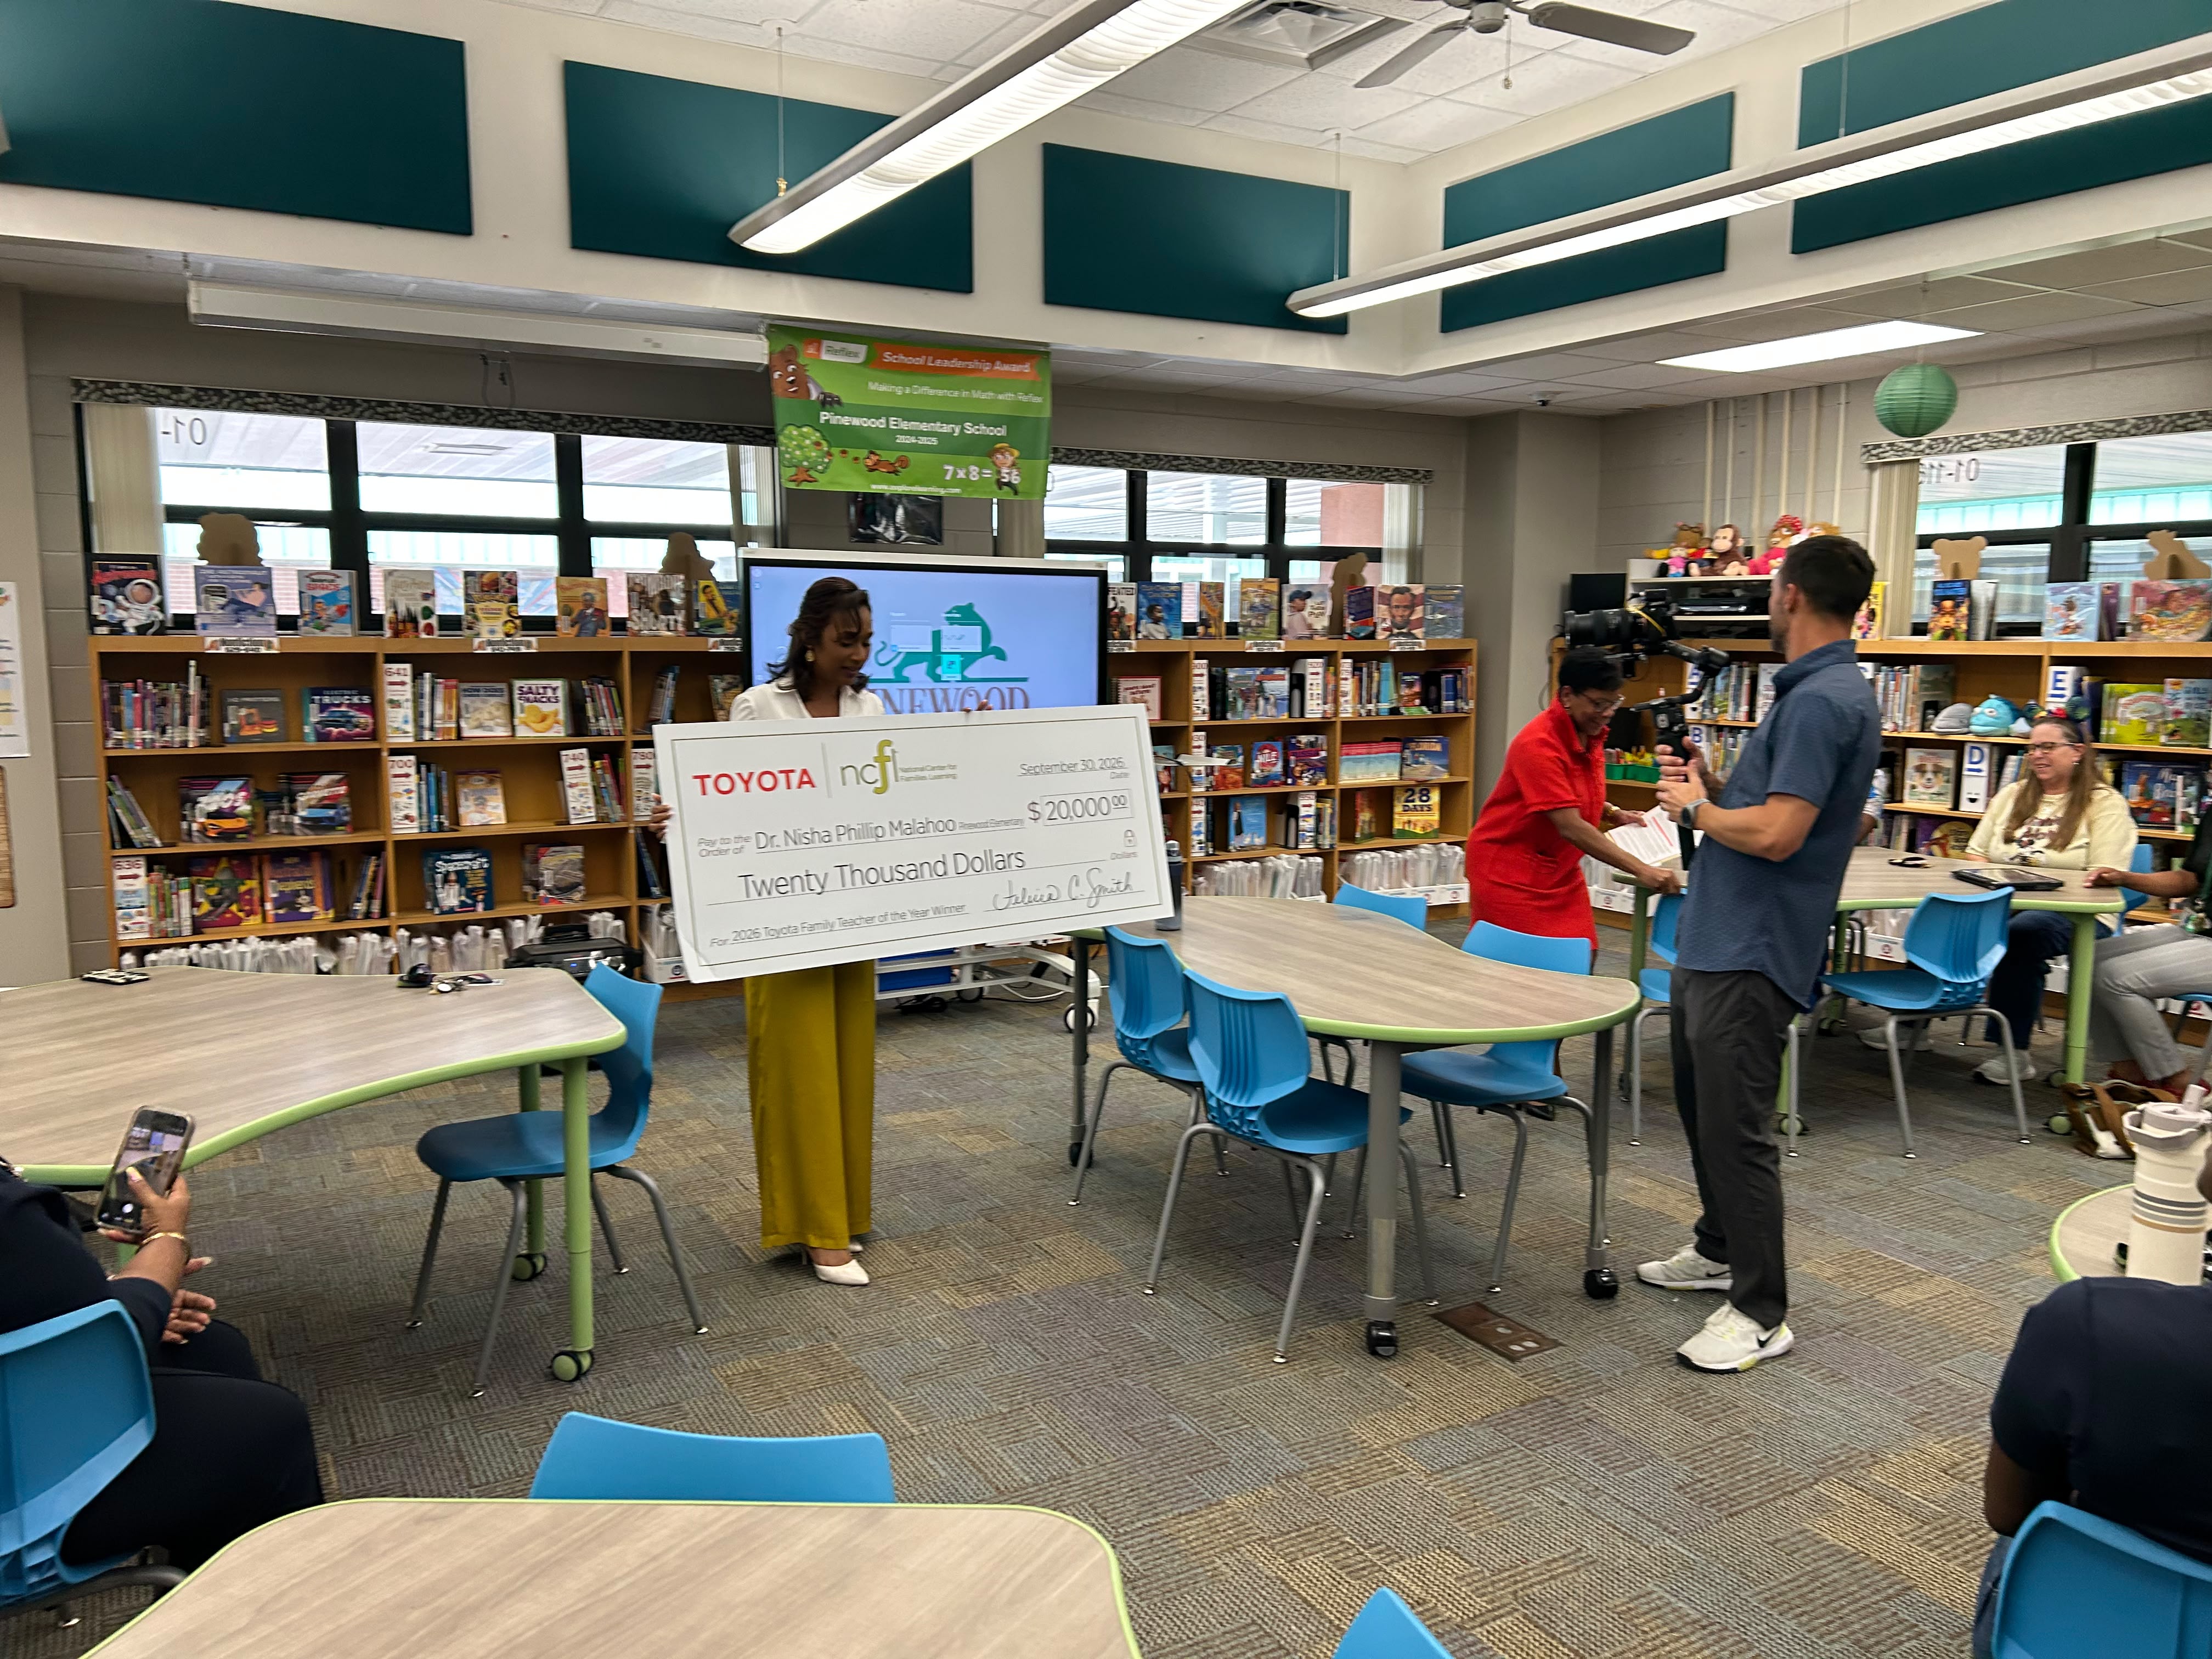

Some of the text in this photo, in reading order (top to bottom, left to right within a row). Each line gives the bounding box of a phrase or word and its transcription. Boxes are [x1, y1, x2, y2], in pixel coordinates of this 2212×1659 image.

[824, 345, 861, 358] Reflex
[882, 351, 1031, 373] School Leadership Award
[867, 381, 904, 395] Making
[911, 385, 960, 397] Difference
[961, 389, 970, 398] in
[971, 390, 995, 399] Math
[996, 391, 1017, 401] with
[1017, 392, 1044, 403] Reflex
[819, 411, 1007, 436] Pinewood Elementary School
[895, 435, 939, 445] 2024-2025
[1000, 467, 1022, 484] 56
[385, 668, 408, 676] 641
[2050, 670, 2068, 691] E
[518, 686, 560, 695] SALTY
[311, 696, 373, 704] TRUCKS
[868, 686, 1030, 715] NEWOOD
[1692, 727, 1702, 743] B
[1968, 746, 1985, 765] D
[388, 759, 414, 769] 700
[1020, 759, 1079, 776] September
[1098, 757, 1125, 769] 2026
[692, 768, 816, 796] TOYOTA
[1110, 771, 1130, 780] Date
[1404, 787, 1431, 803] 28
[754, 831, 781, 849] Dr.
[783, 827, 833, 847] Nisha
[835, 822, 887, 843] Phillip
[888, 817, 957, 838] Malahoo
[697, 835, 753, 848] Pay to the
[698, 845, 746, 857] Order of
[1110, 851, 1139, 860] Dollars
[114, 860, 143, 870] 636
[737, 849, 1027, 899] Twenty Thousand Dollars
[1085, 867, 1135, 909] Smith
[709, 904, 967, 947] For 2026 Toyota Family Teacher of the Year Winner
